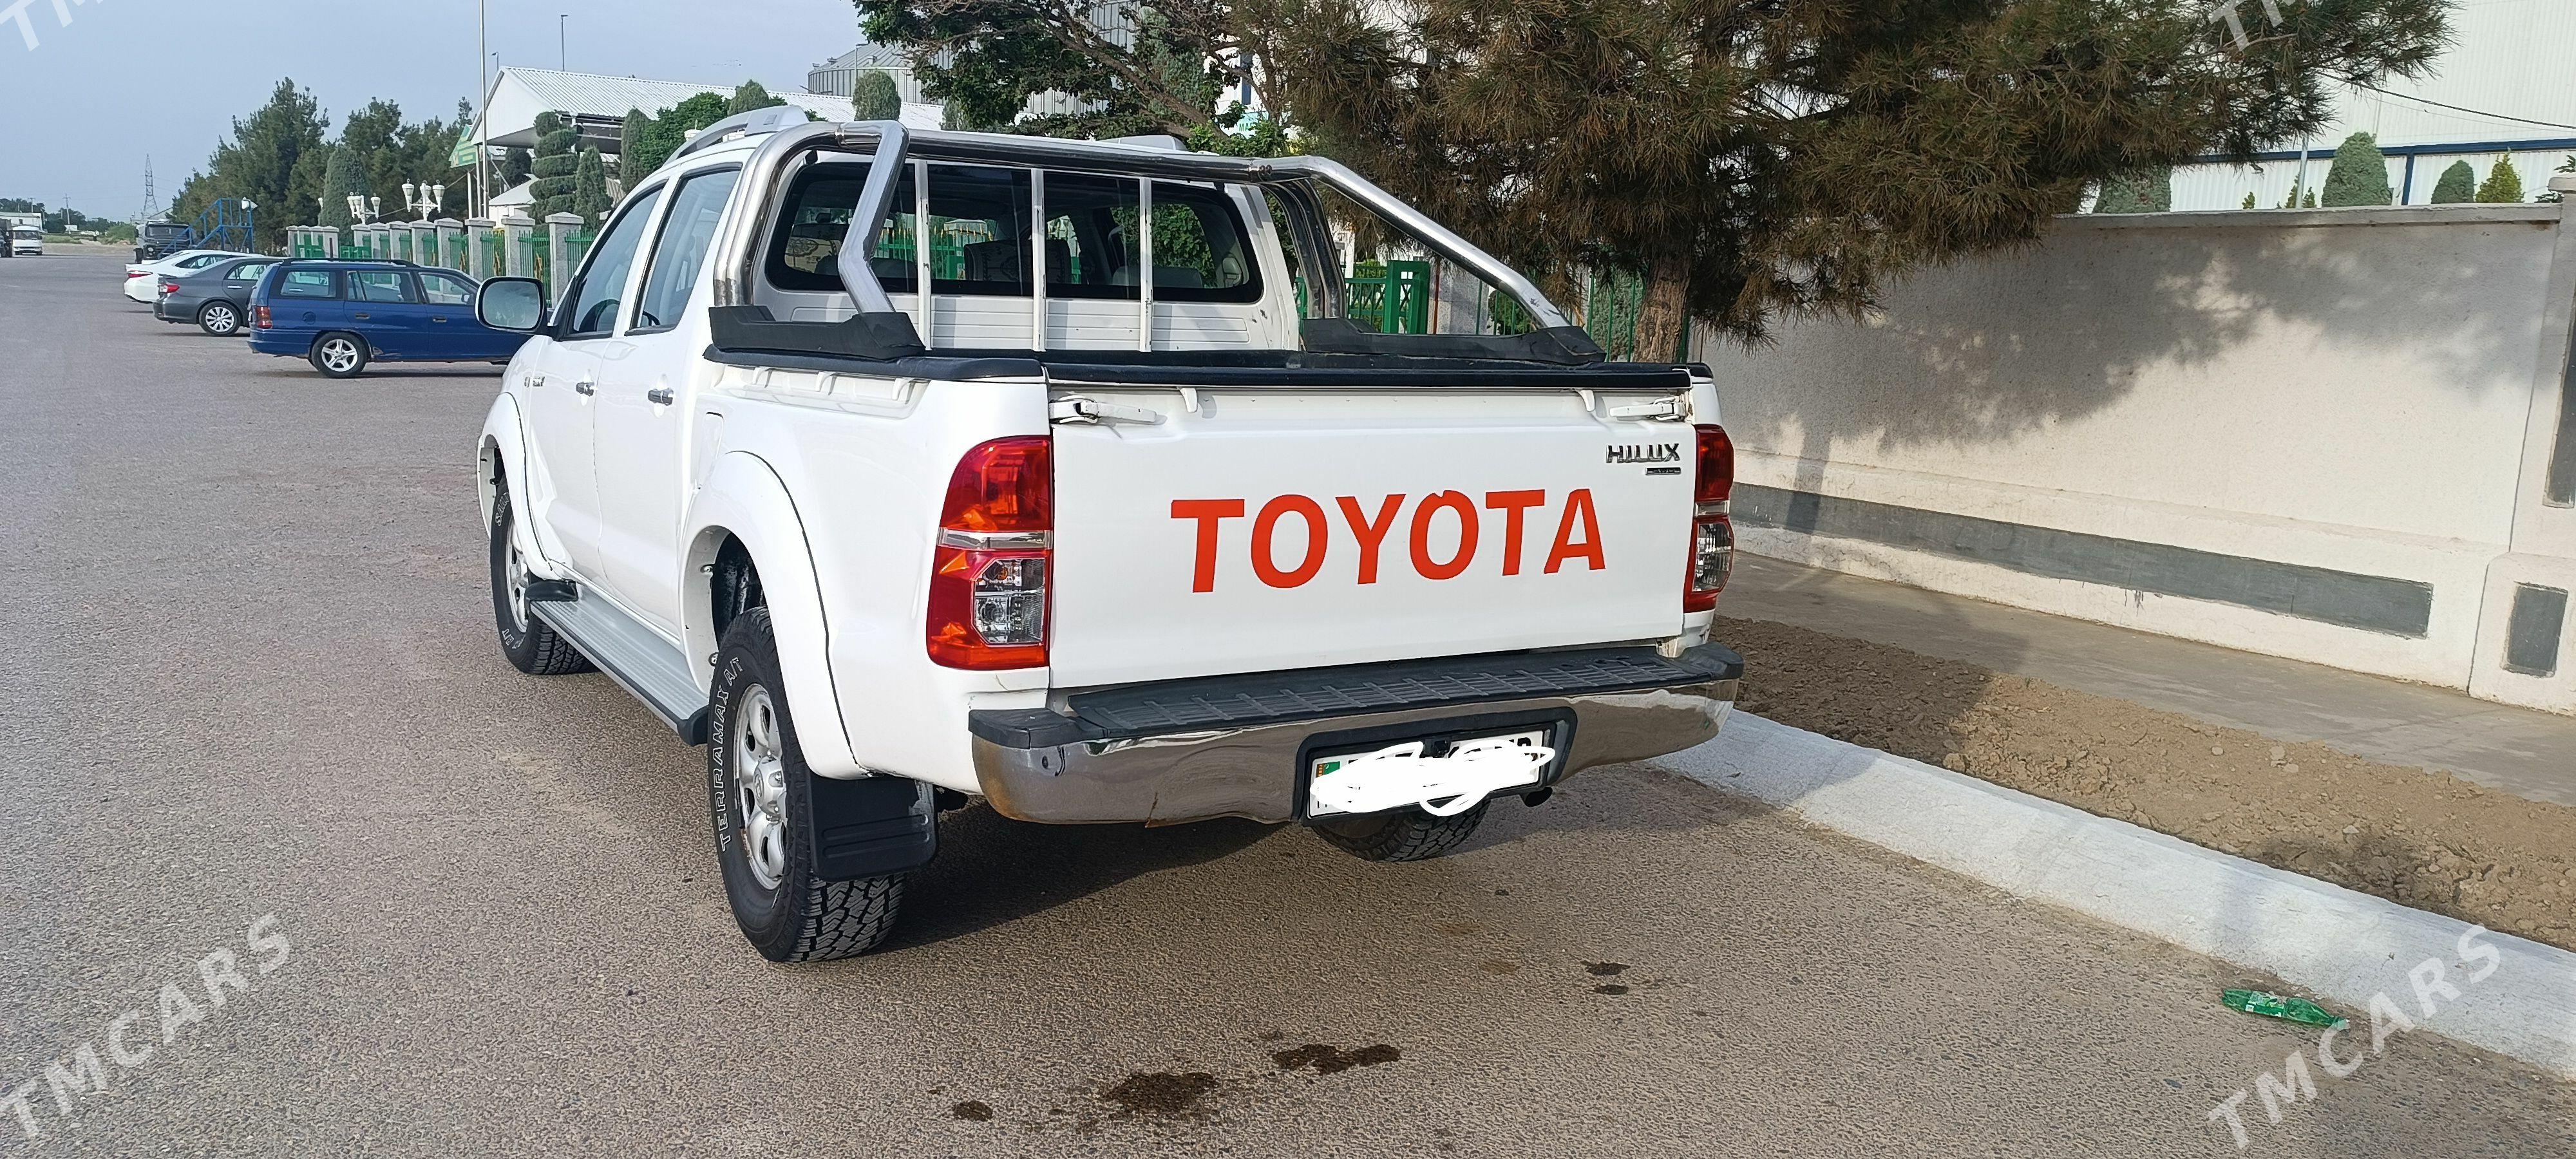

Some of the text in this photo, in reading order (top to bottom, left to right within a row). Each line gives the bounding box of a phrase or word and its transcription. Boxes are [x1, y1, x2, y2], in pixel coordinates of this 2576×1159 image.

[1605, 442, 1681, 464] HILUX
[1170, 488, 1606, 594] TOYOTA
[712, 657, 743, 852] TERRAMAX A/T
